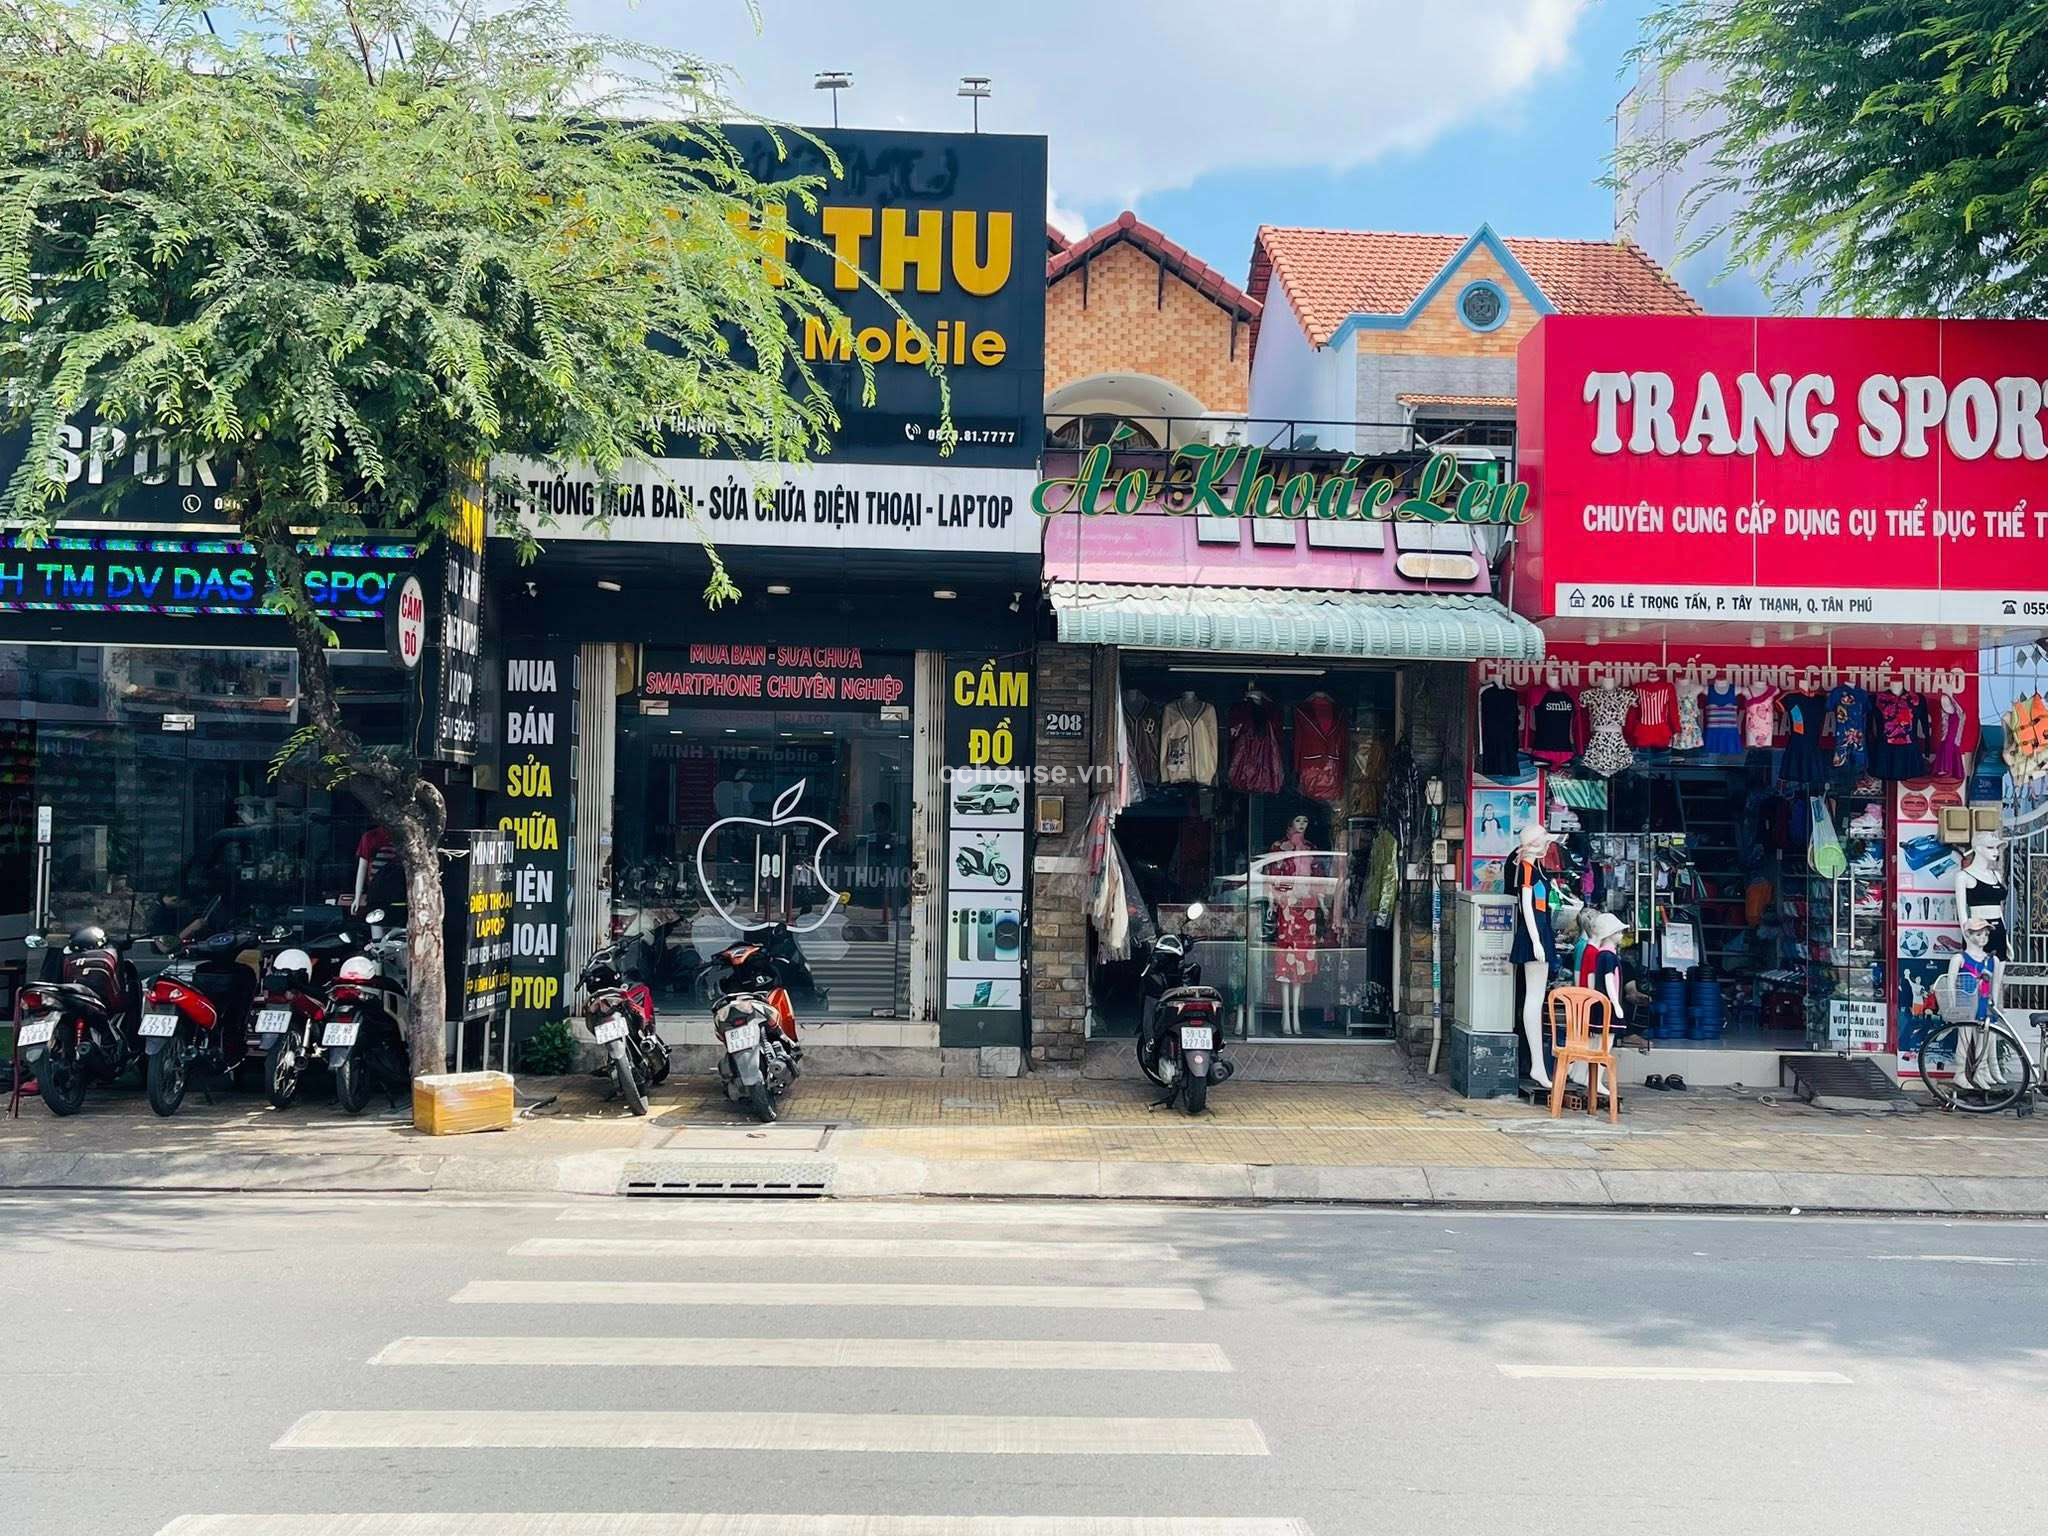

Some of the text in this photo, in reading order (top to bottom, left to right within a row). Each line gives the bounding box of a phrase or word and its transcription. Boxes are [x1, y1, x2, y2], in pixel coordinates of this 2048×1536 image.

[822, 206, 1013, 296] THU
[804, 315, 1008, 366] Mobile
[1583, 370, 2048, 462] TRANG SPOR
[1031, 425, 1154, 518] Áo
[1164, 443, 1397, 521] Khoác
[1394, 452, 1536, 526] Len
[528, 471, 595, 515] THỐNG
[709, 475, 749, 521] SỬA
[814, 484, 860, 530] ĐIỆN
[865, 491, 922, 531] THOẠI
[937, 495, 1013, 529] LAPTOP
[1583, 501, 1665, 534] CHUYÊN
[1672, 506, 1727, 535] CUNG
[1735, 500, 1777, 536] CẤP
[1784, 509, 1840, 542] DỤNG
[1849, 510, 1878, 543] CỤ
[1885, 498, 1927, 538] THỂ
[1932, 510, 1977, 543] DỤC
[1983, 499, 2026, 539] THỂ
[37, 563, 95, 598] TM
[107, 565, 164, 599] DV
[172, 567, 255, 601] DAS
[304, 569, 397, 605] SPO
[1592, 592, 1872, 614] 206 LÊ TRỌNG TẤN, P. TÂY THẠNH, Q. TÂN PHÚ
[689, 644, 730, 665] MUA
[508, 660, 557, 693] MUA
[646, 671, 904, 705] SMARTPHONE CHUYÊN NGHIỆP
[954, 658, 1029, 707] CẦM
[1900, 667, 1966, 695] THAO
[508, 705, 555, 745] BÁN
[1046, 714, 1082, 731] 208
[1545, 701, 1573, 711] smile
[968, 717, 1014, 766] ĐỒ
[508, 754, 553, 798] SỬA
[471, 840, 514, 866] MINH THU
[489, 891, 513, 914] THOẠI
[516, 863, 554, 910] IỆN
[476, 916, 505, 938] LAPTOP
[511, 977, 558, 1010] PTOP
